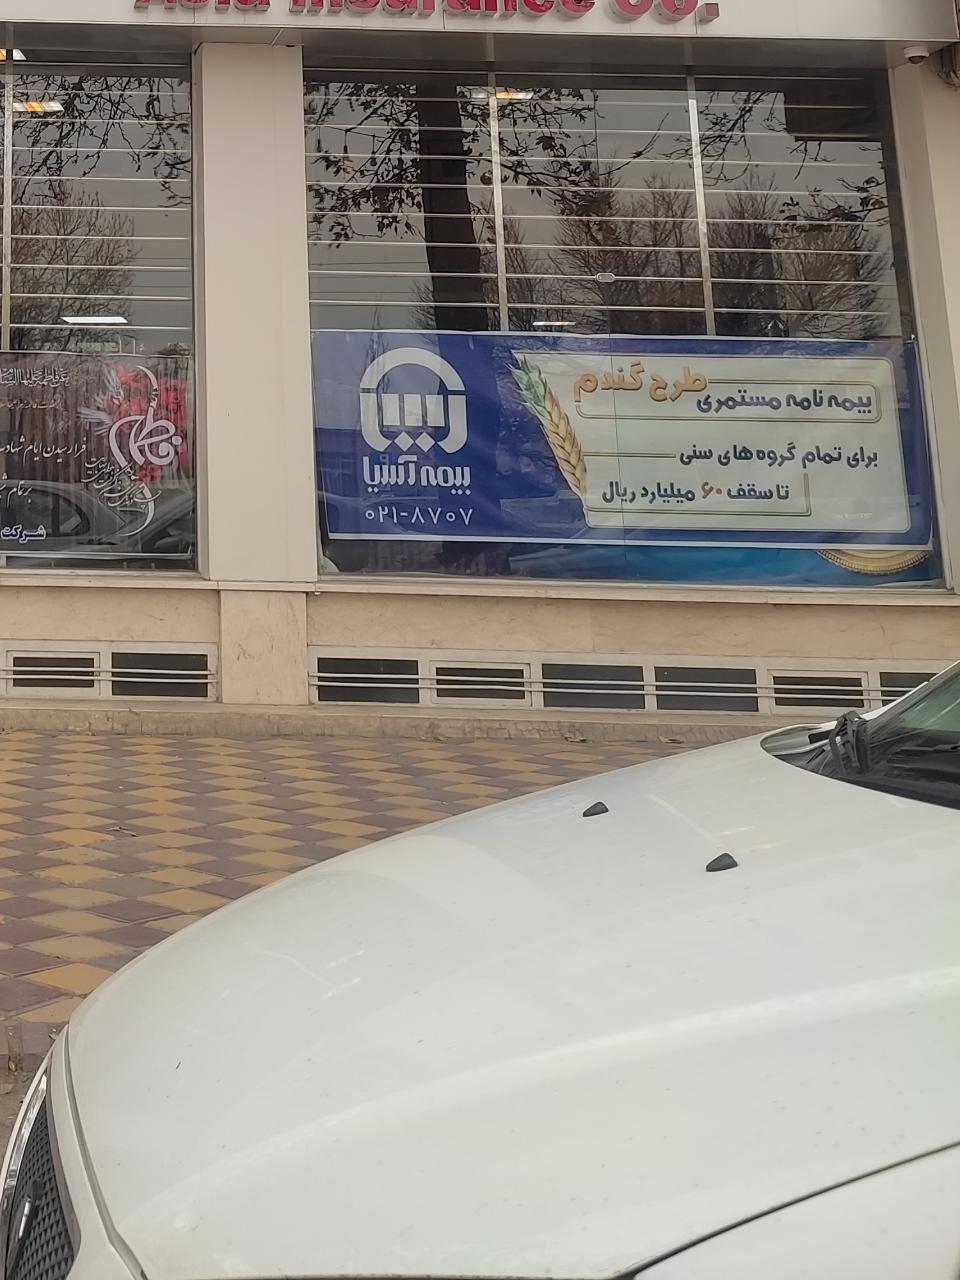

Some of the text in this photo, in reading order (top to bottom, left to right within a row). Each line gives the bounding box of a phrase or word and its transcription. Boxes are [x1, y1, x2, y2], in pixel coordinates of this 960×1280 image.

[573, 360, 708, 403] طرح گندم
[696, 388, 873, 415] بیمه نامه مستمری
[679, 443, 714, 466] سنی
[801, 444, 843, 470] تمام
[846, 446, 879, 469] برای
[362, 454, 472, 496] بیمه آسیا
[601, 480, 636, 504] ریال
[640, 482, 696, 504] میلیارد
[701, 481, 723, 500] ۶۰
[365, 505, 473, 526] ۰۲۱-۸۷۰۷
[0, 524, 47, 544] شرکت
